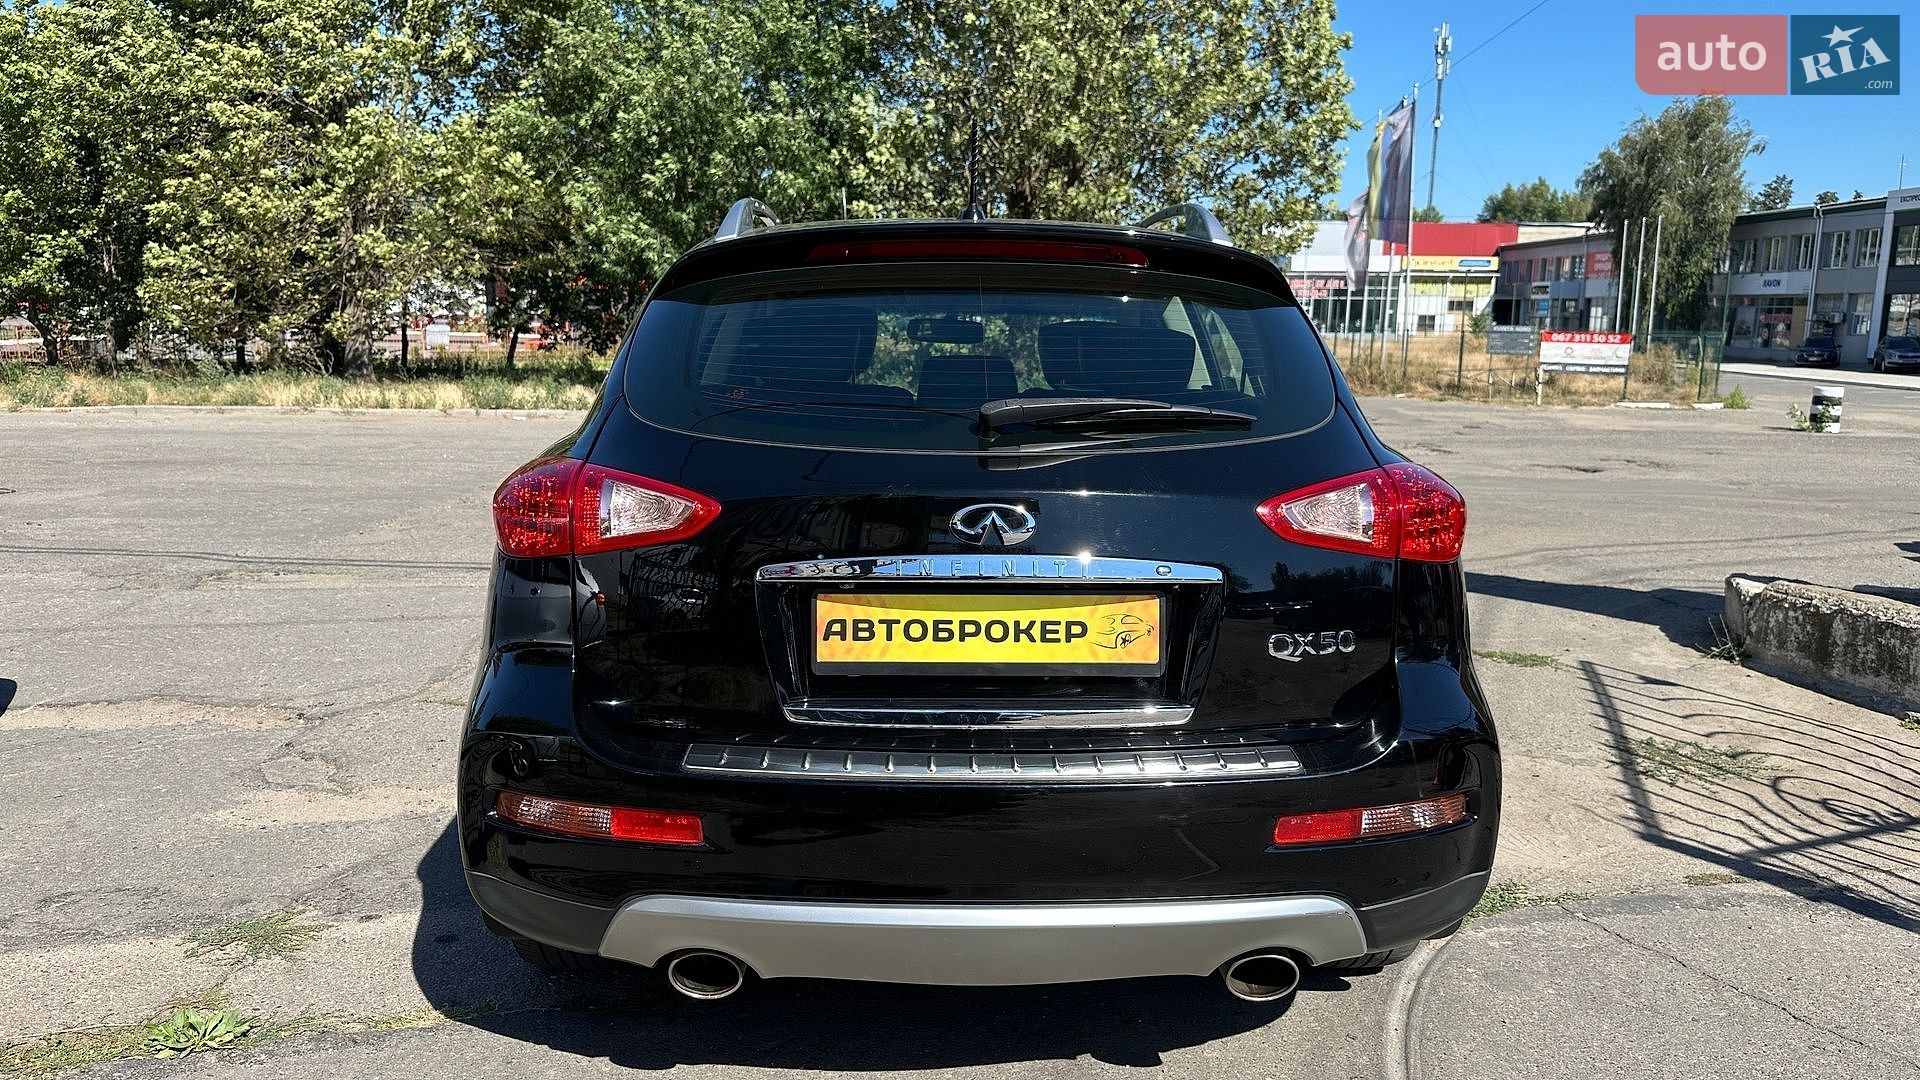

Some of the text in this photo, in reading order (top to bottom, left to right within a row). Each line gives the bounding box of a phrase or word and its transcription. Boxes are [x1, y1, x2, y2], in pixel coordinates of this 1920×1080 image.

[1551, 333, 1621, 343] 067 311 50 52
[895, 558, 1089, 579] INFINITI
[822, 618, 1088, 644] АВТОБРОКЕР
[1268, 629, 1356, 662] QX50
